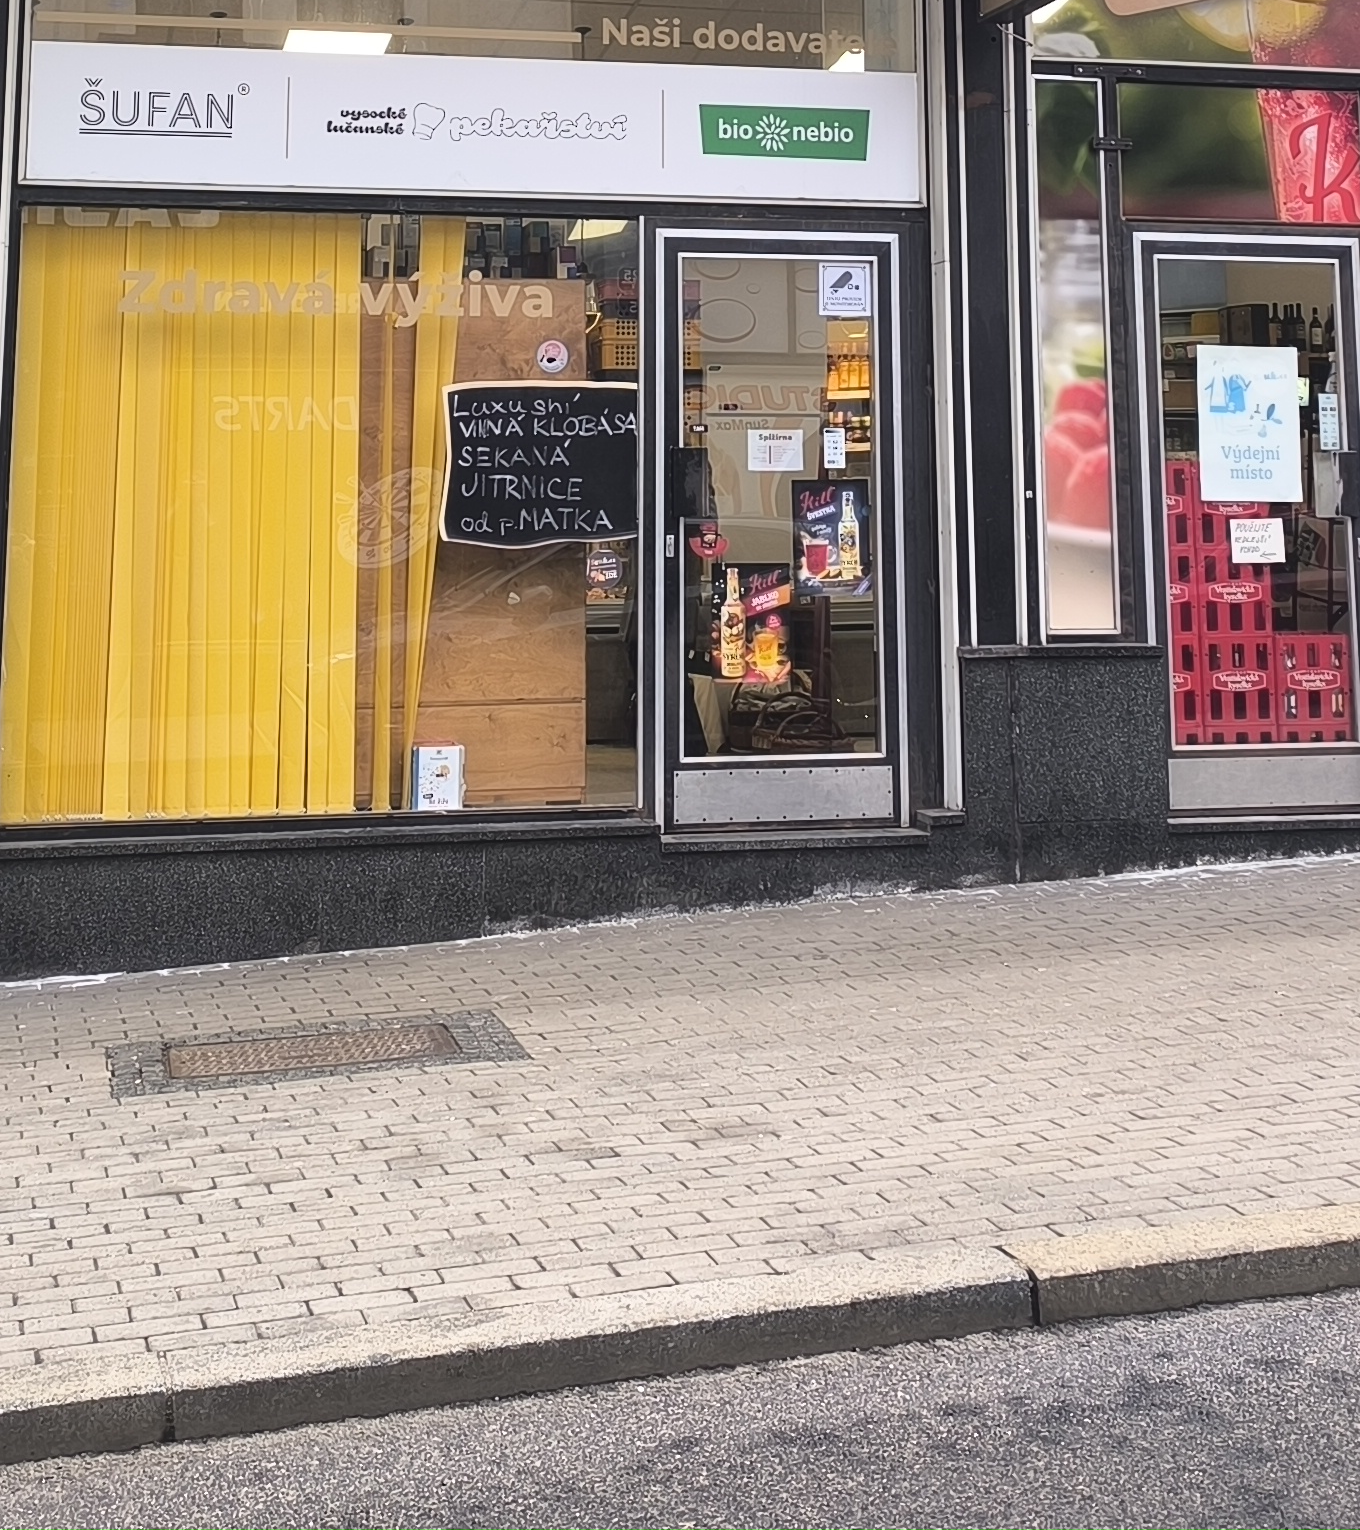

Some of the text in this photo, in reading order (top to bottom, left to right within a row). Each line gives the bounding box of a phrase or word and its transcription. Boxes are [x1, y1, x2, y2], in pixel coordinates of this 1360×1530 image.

[601, 16, 894, 56] Naši dodavate
[79, 77, 234, 130] ŠUFAN
[340, 107, 408, 121] vysocké
[326, 120, 405, 135] lučanské
[449, 108, 628, 142] pekařství
[718, 118, 854, 144] bio nebio
[118, 268, 334, 315] Zdravá
[358, 269, 554, 328] výživa
[457, 438, 572, 468] SEKANÁ
[1220, 444, 1281, 464] Výdejní
[1229, 464, 1274, 480] místo
[461, 472, 583, 501] JITRNICE
[460, 510, 493, 533] od
